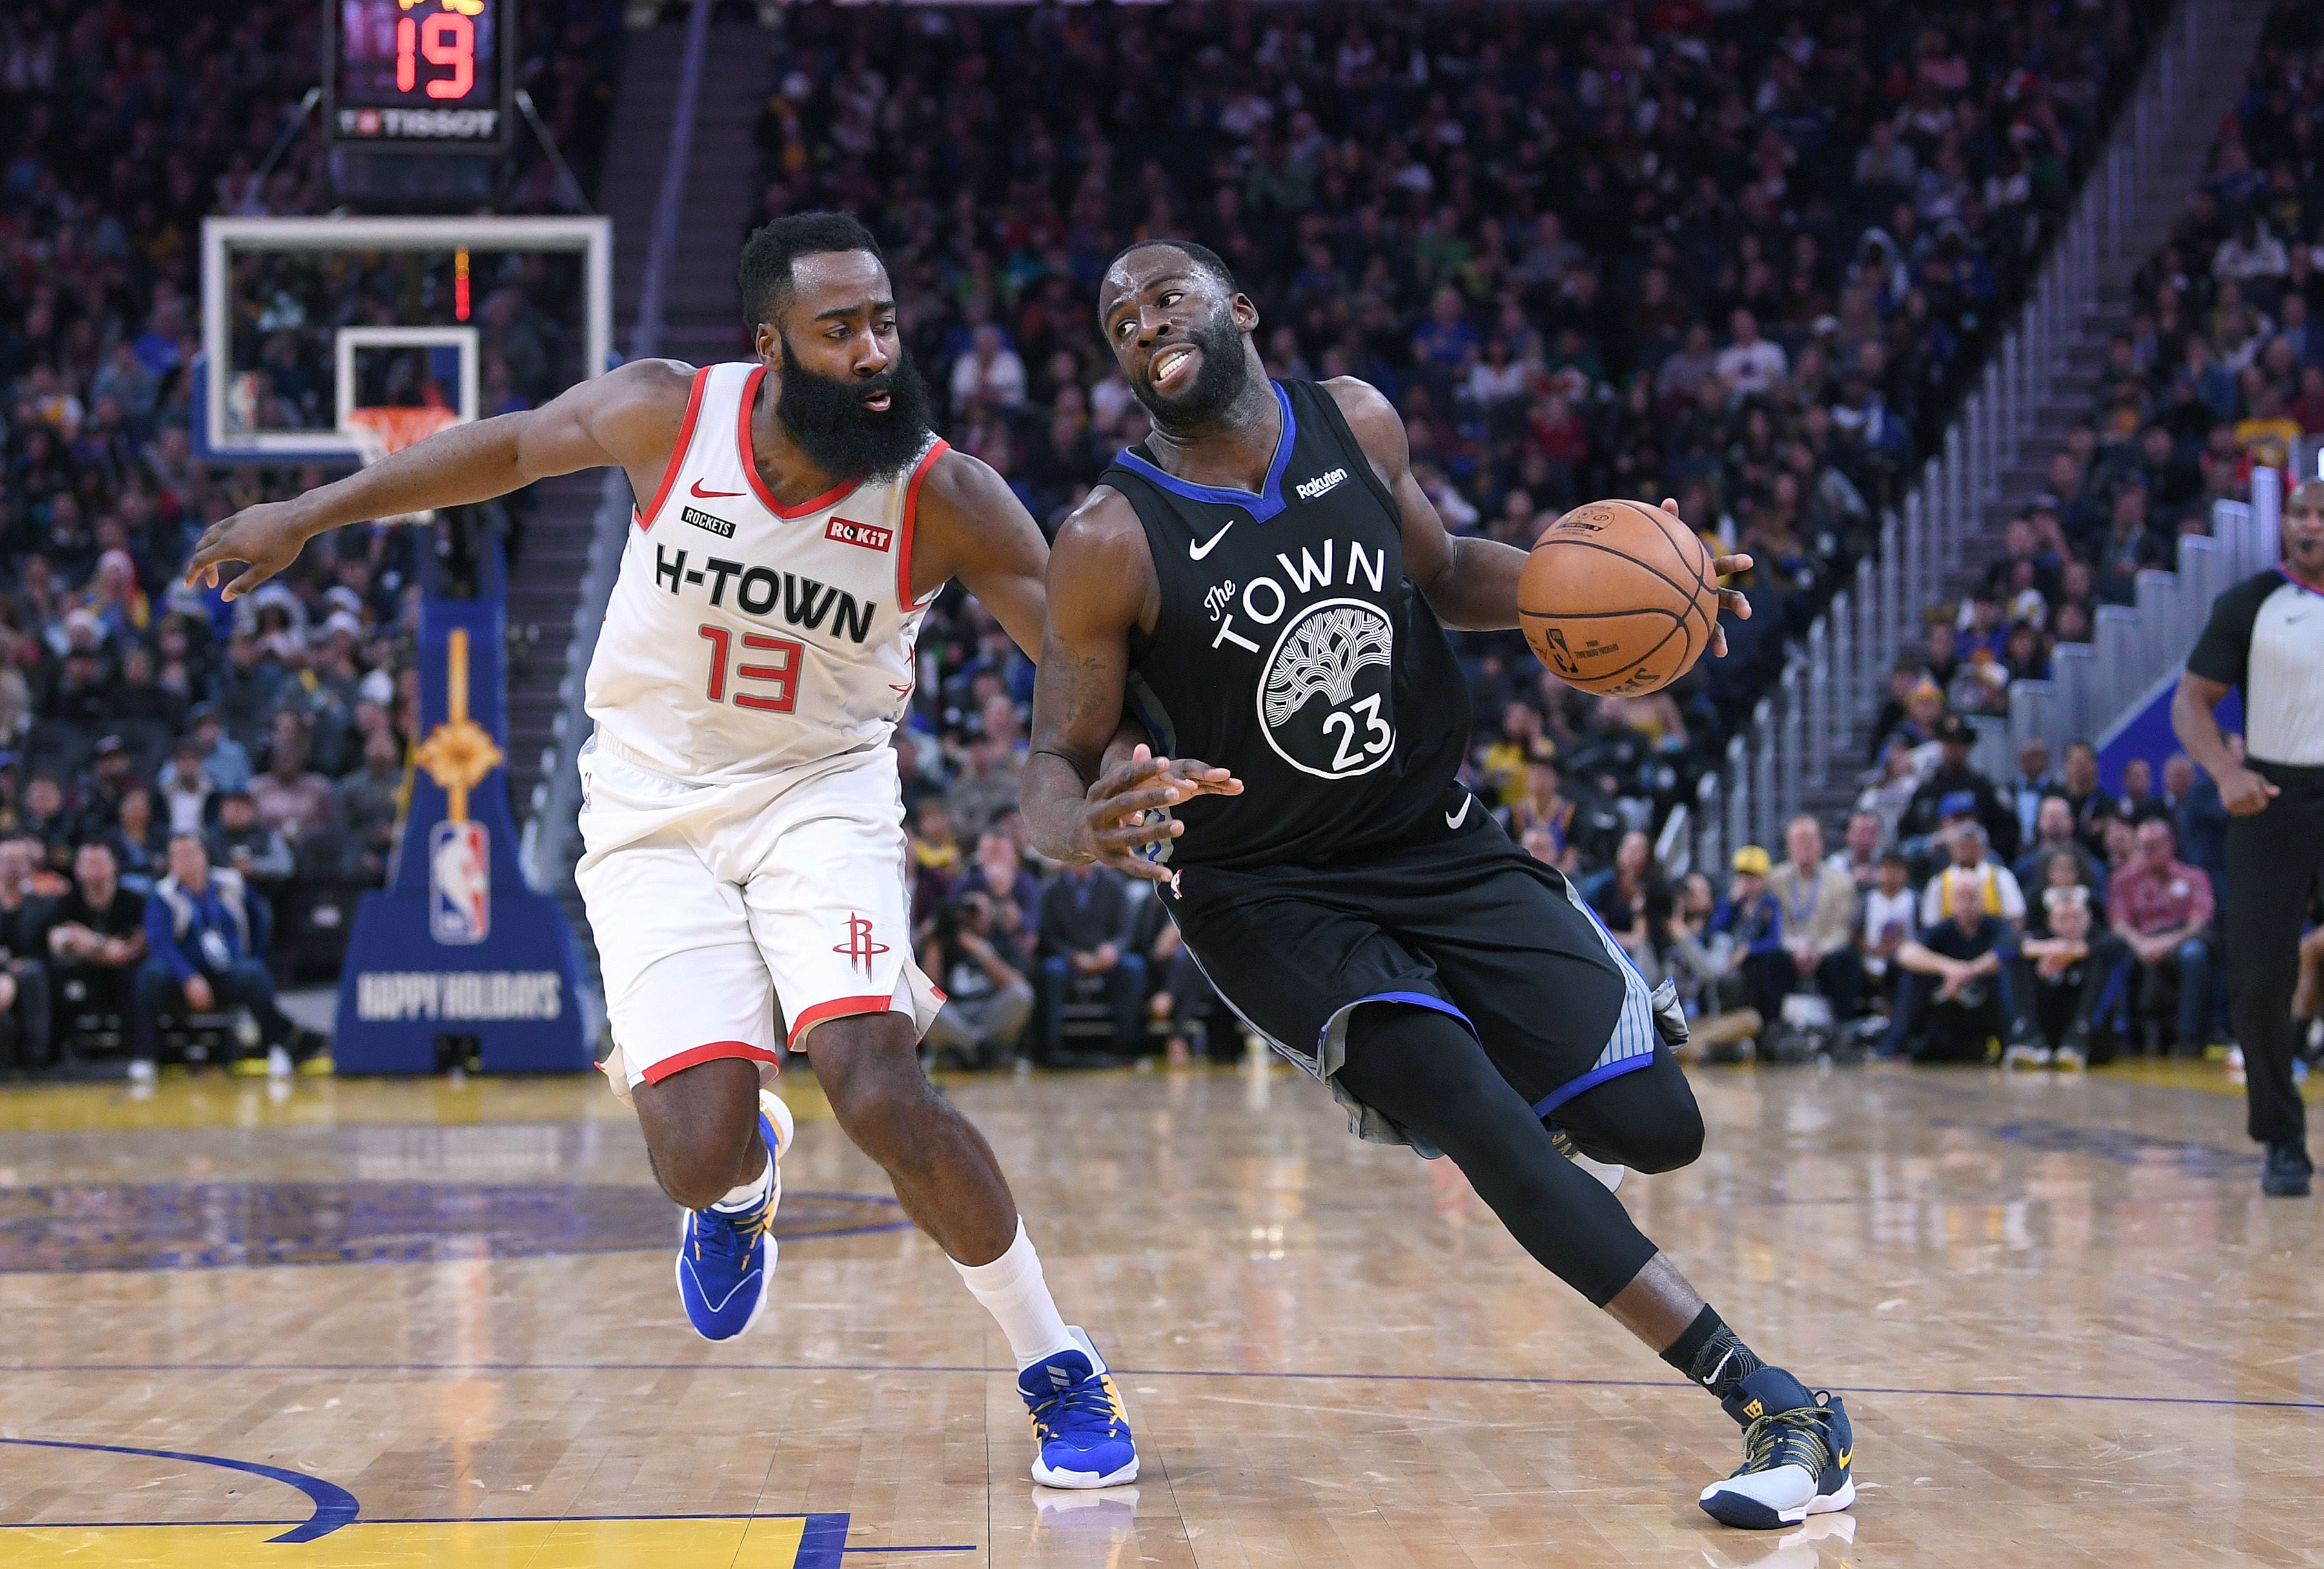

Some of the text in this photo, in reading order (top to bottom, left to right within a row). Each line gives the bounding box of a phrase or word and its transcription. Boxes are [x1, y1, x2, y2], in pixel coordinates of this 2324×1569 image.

[396, 12, 474, 99] 19
[684, 509, 732, 536] ROCKETS
[1296, 467, 1348, 500] Rakuten
[656, 542, 877, 643] H-TOWN
[1203, 579, 1236, 622] The
[1212, 538, 1385, 654] TOWN
[698, 623, 806, 715] 13
[1322, 692, 1391, 771] 23
